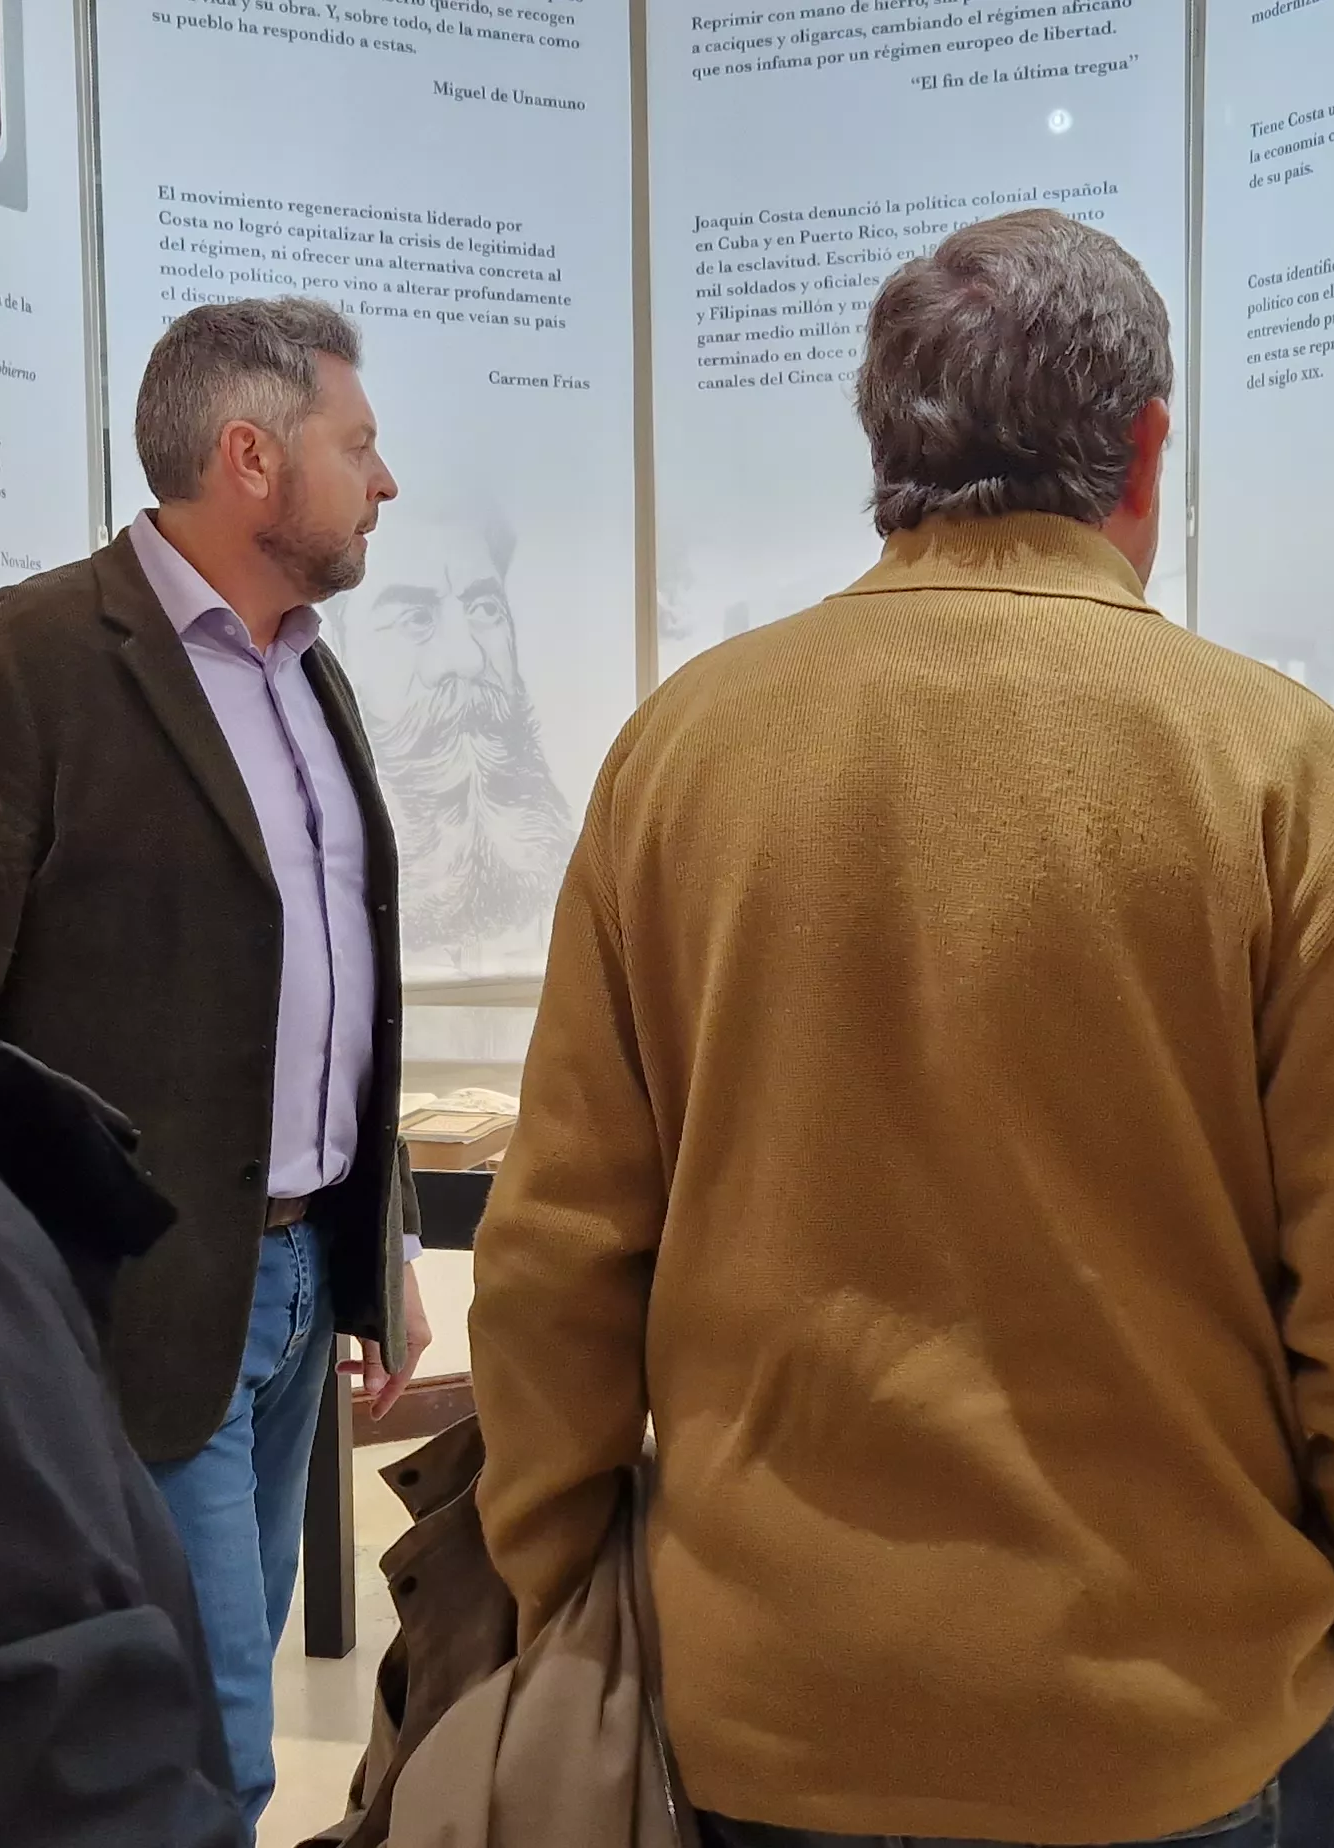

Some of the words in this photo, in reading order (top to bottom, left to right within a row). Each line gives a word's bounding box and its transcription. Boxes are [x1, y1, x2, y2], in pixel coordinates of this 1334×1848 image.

[152, 12, 171, 24] su
[177, 14, 233, 31] pueblo
[238, 17, 259, 34] ha
[263, 26, 355, 46] respondido
[360, 38, 369, 48] a
[373, 40, 416, 54] estas.
[692, 66, 720, 81] que
[725, 63, 752, 74] nos
[757, 55, 813, 71] infama
[817, 53, 845, 70] por
[849, 50, 869, 62] un
[874, 42, 941, 62] régimen
[947, 36, 1013, 52] europeo
[1019, 29, 1039, 44] de
[1043, 20, 1116, 41] libertad.
[911, 75, 937, 90] “El
[943, 73, 964, 88] fin
[969, 71, 988, 85] de
[993, 69, 1009, 83] la
[1013, 64, 1069, 80] última
[1075, 54, 1138, 76] tregua”
[433, 80, 486, 101] Miguel
[491, 88, 508, 102] de
[512, 90, 585, 110] Unamuno
[1250, 120, 1284, 138] Tiene
[1288, 109, 1325, 127] Costa
[1250, 150, 1261, 164] la
[1264, 132, 1325, 160] economía
[158, 185, 175, 200] El
[181, 191, 283, 210] movimiento
[288, 202, 423, 223] regeneracionista
[427, 210, 491, 230] liderado
[496, 221, 522, 235] por
[692, 212, 754, 233] Joaquín
[759, 210, 804, 224] Costa
[809, 201, 881, 220] denunció
[886, 200, 901, 213] la
[906, 194, 967, 216] política
[972, 187, 1037, 206] colonial
[1043, 180, 1118, 202] española
[159, 210, 208, 228] Costa
[213, 220, 233, 230] no
[239, 217, 282, 238] logró
[288, 224, 375, 242] capitalizar
[379, 230, 394, 244] la
[399, 233, 441, 248] crisis
[446, 236, 464, 251] de
[468, 237, 555, 258] legitimidad
[695, 242, 713, 252] en
[718, 235, 759, 250] Cuba
[763, 238, 772, 251] y
[777, 236, 795, 246] en
[800, 230, 853, 244] Puerto
[859, 224, 897, 239] Rico,
[903, 220, 949, 238] sobre
[159, 236, 185, 252] del
[191, 240, 266, 260] régimen,
[271, 246, 287, 260] ni
[292, 248, 350, 264] ofrecer
[355, 256, 385, 268] una
[389, 255, 475, 275] alternativa
[479, 267, 544, 280] concreta
[548, 268, 561, 282] al
[161, 263, 224, 279] modelo
[229, 268, 297, 288] político,
[303, 277, 338, 290] pero
[344, 276, 377, 291] vino
[383, 283, 392, 292] a
[397, 280, 450, 296] alterar
[455, 286, 571, 306] profundamente
[1248, 274, 1283, 289] Costa
[5, 293, 18, 310] de
[21, 296, 32, 314] la
[1248, 294, 1293, 319] político
[1297, 292, 1319, 304] con
[1323, 283, 1334, 299] el
[489, 371, 549, 387] Carmen
[553, 374, 590, 389] Frías
[698, 374, 755, 390] canales
[760, 372, 783, 386] del
[788, 370, 833, 384] Cinca
[1, 552, 42, 570] Novales
